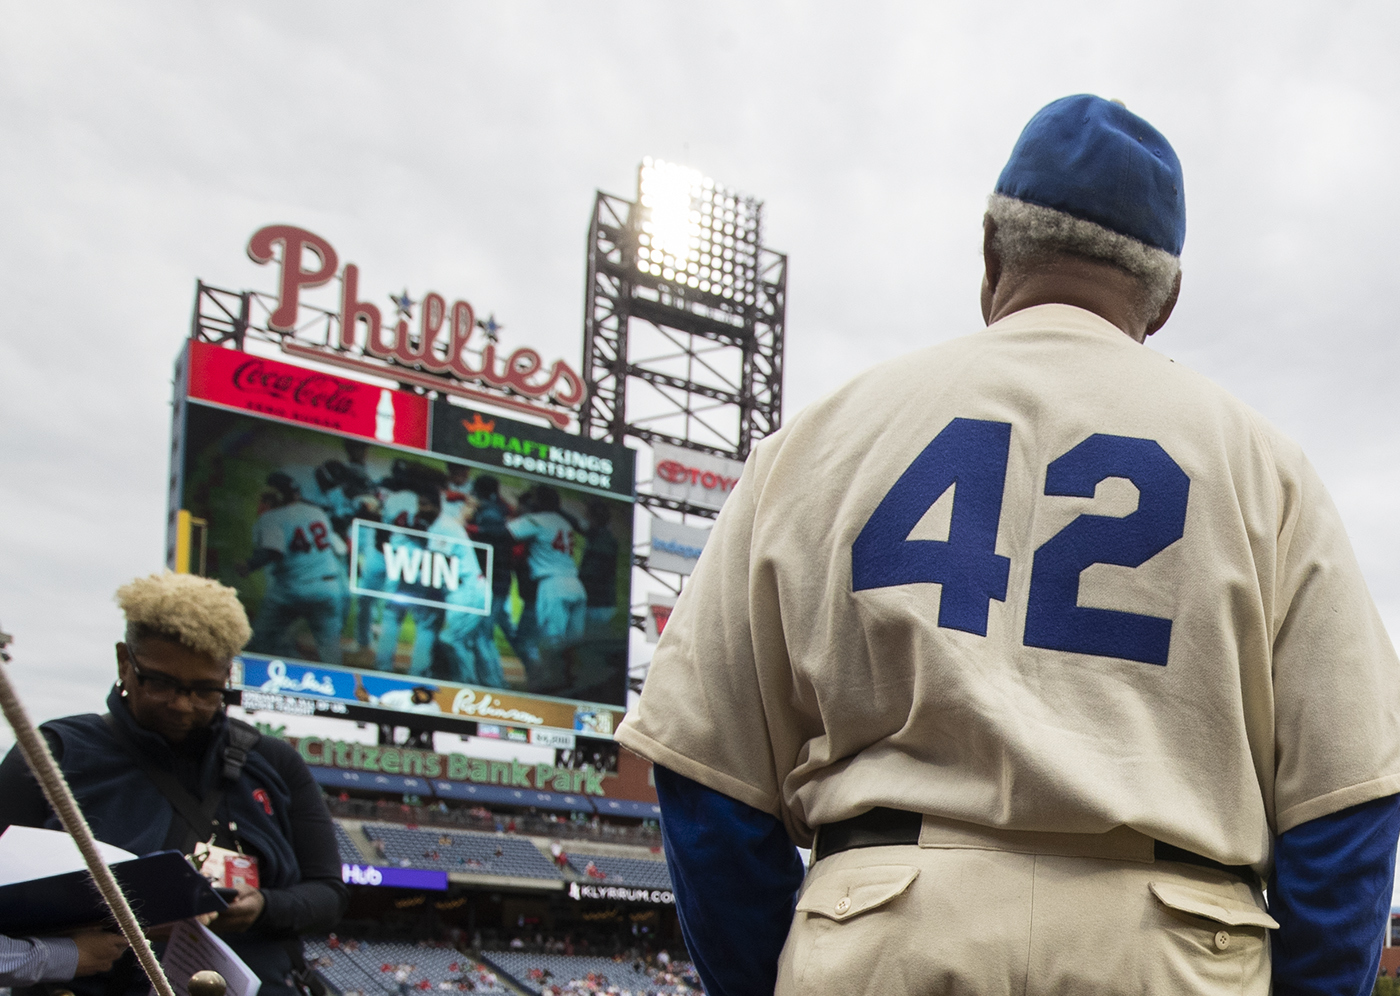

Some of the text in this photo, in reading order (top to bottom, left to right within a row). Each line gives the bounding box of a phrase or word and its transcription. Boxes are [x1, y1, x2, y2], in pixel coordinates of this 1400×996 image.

[247, 225, 587, 406] Phillies
[502, 451, 611, 489] SPORTSBOOK
[382, 542, 460, 591] WIN
[852, 414, 1191, 667] 42
[299, 735, 607, 797] Citizens Bank Park
